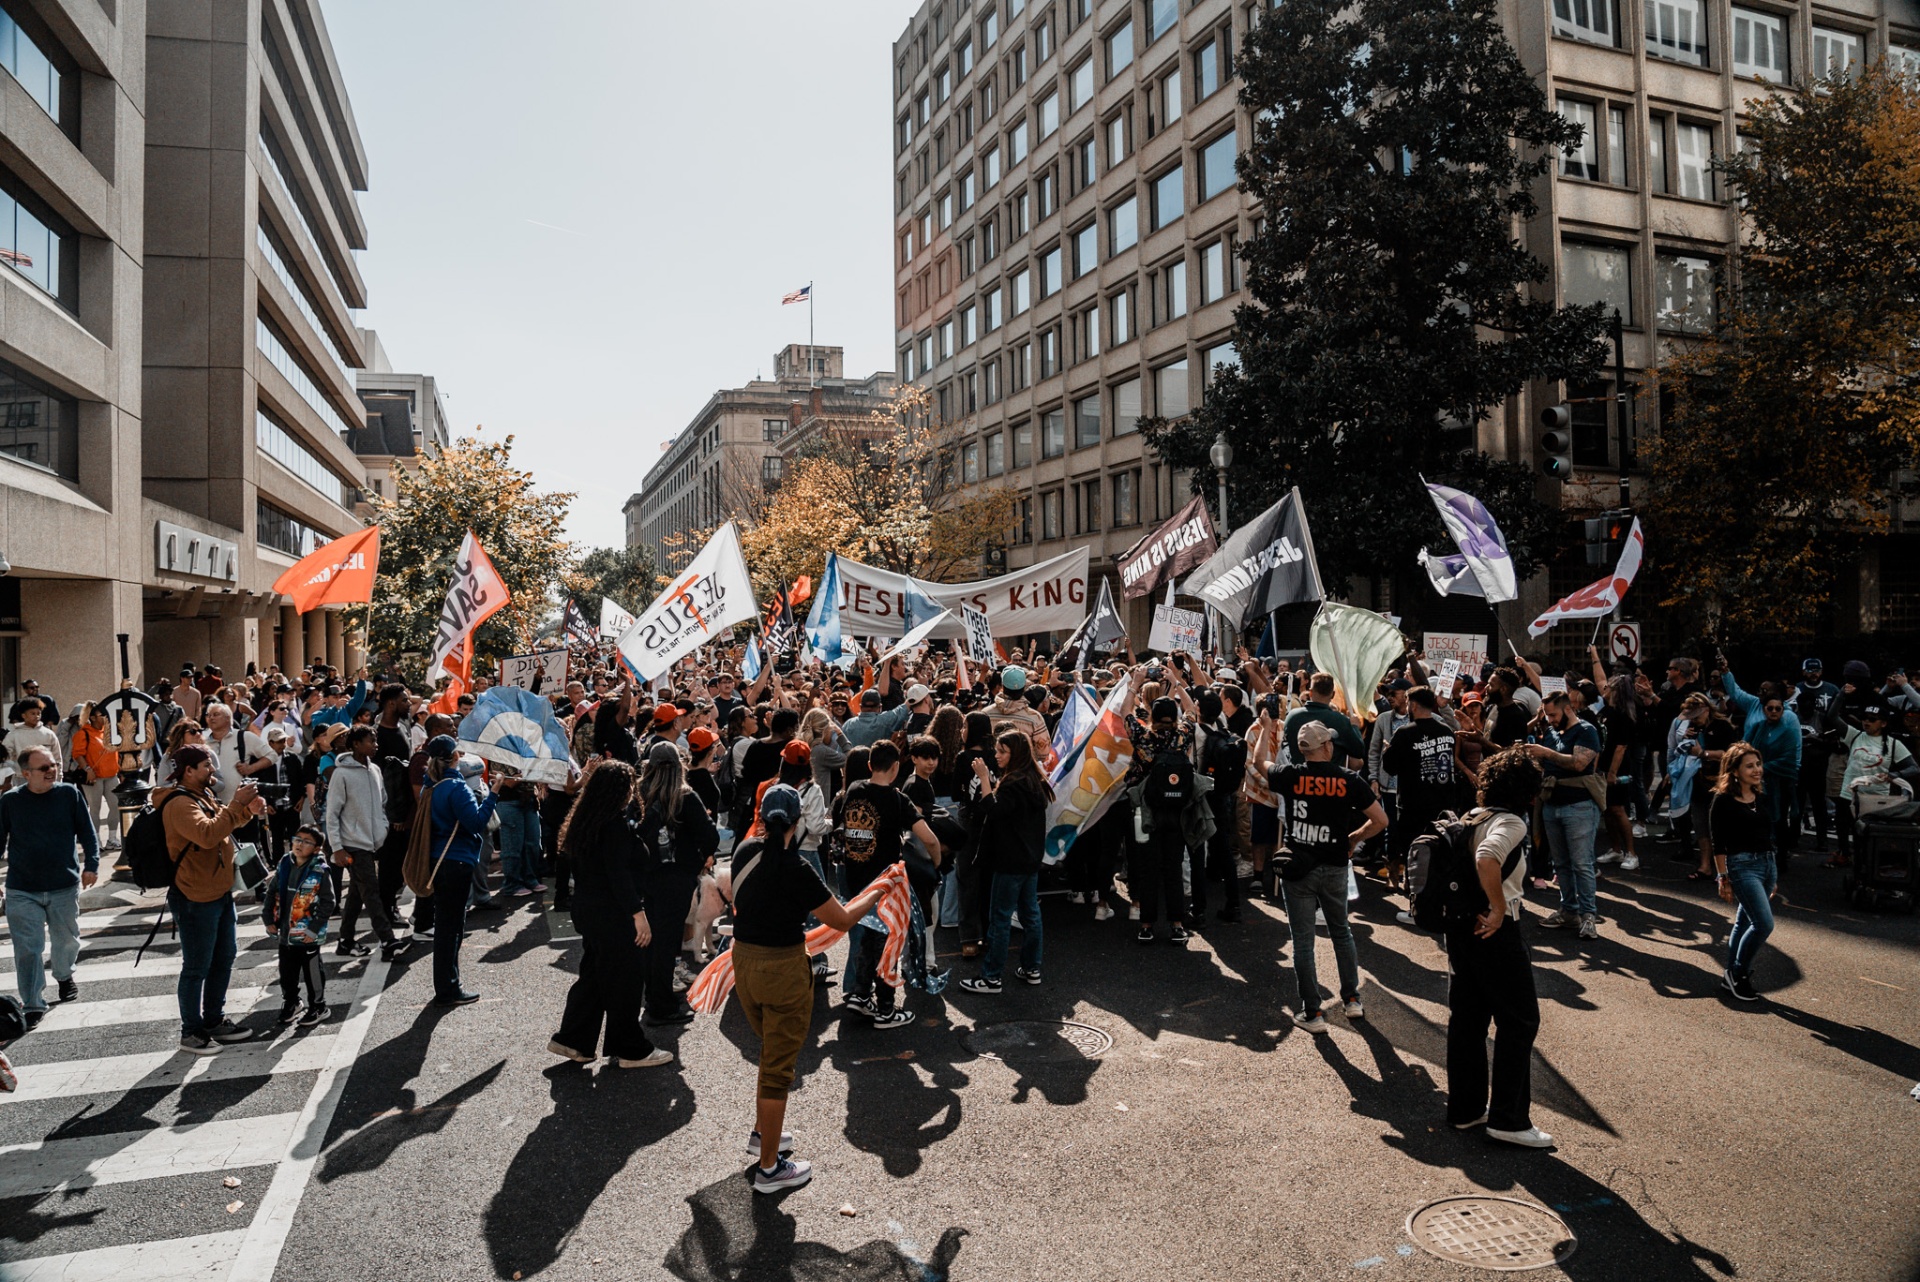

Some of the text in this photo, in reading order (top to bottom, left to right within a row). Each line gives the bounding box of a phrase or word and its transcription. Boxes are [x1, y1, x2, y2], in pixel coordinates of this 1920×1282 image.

[963, 606, 991, 639] THERE
[1156, 606, 1204, 631] JESUS
[973, 630, 987, 648] IS
[1428, 637, 1461, 650] JESUS
[1427, 650, 1487, 665] CHRIST HEALS
[512, 676, 526, 689] Te
[1420, 747, 1436, 757] FOR
[1293, 775, 1347, 797] JESUS
[1292, 799, 1308, 819] IS
